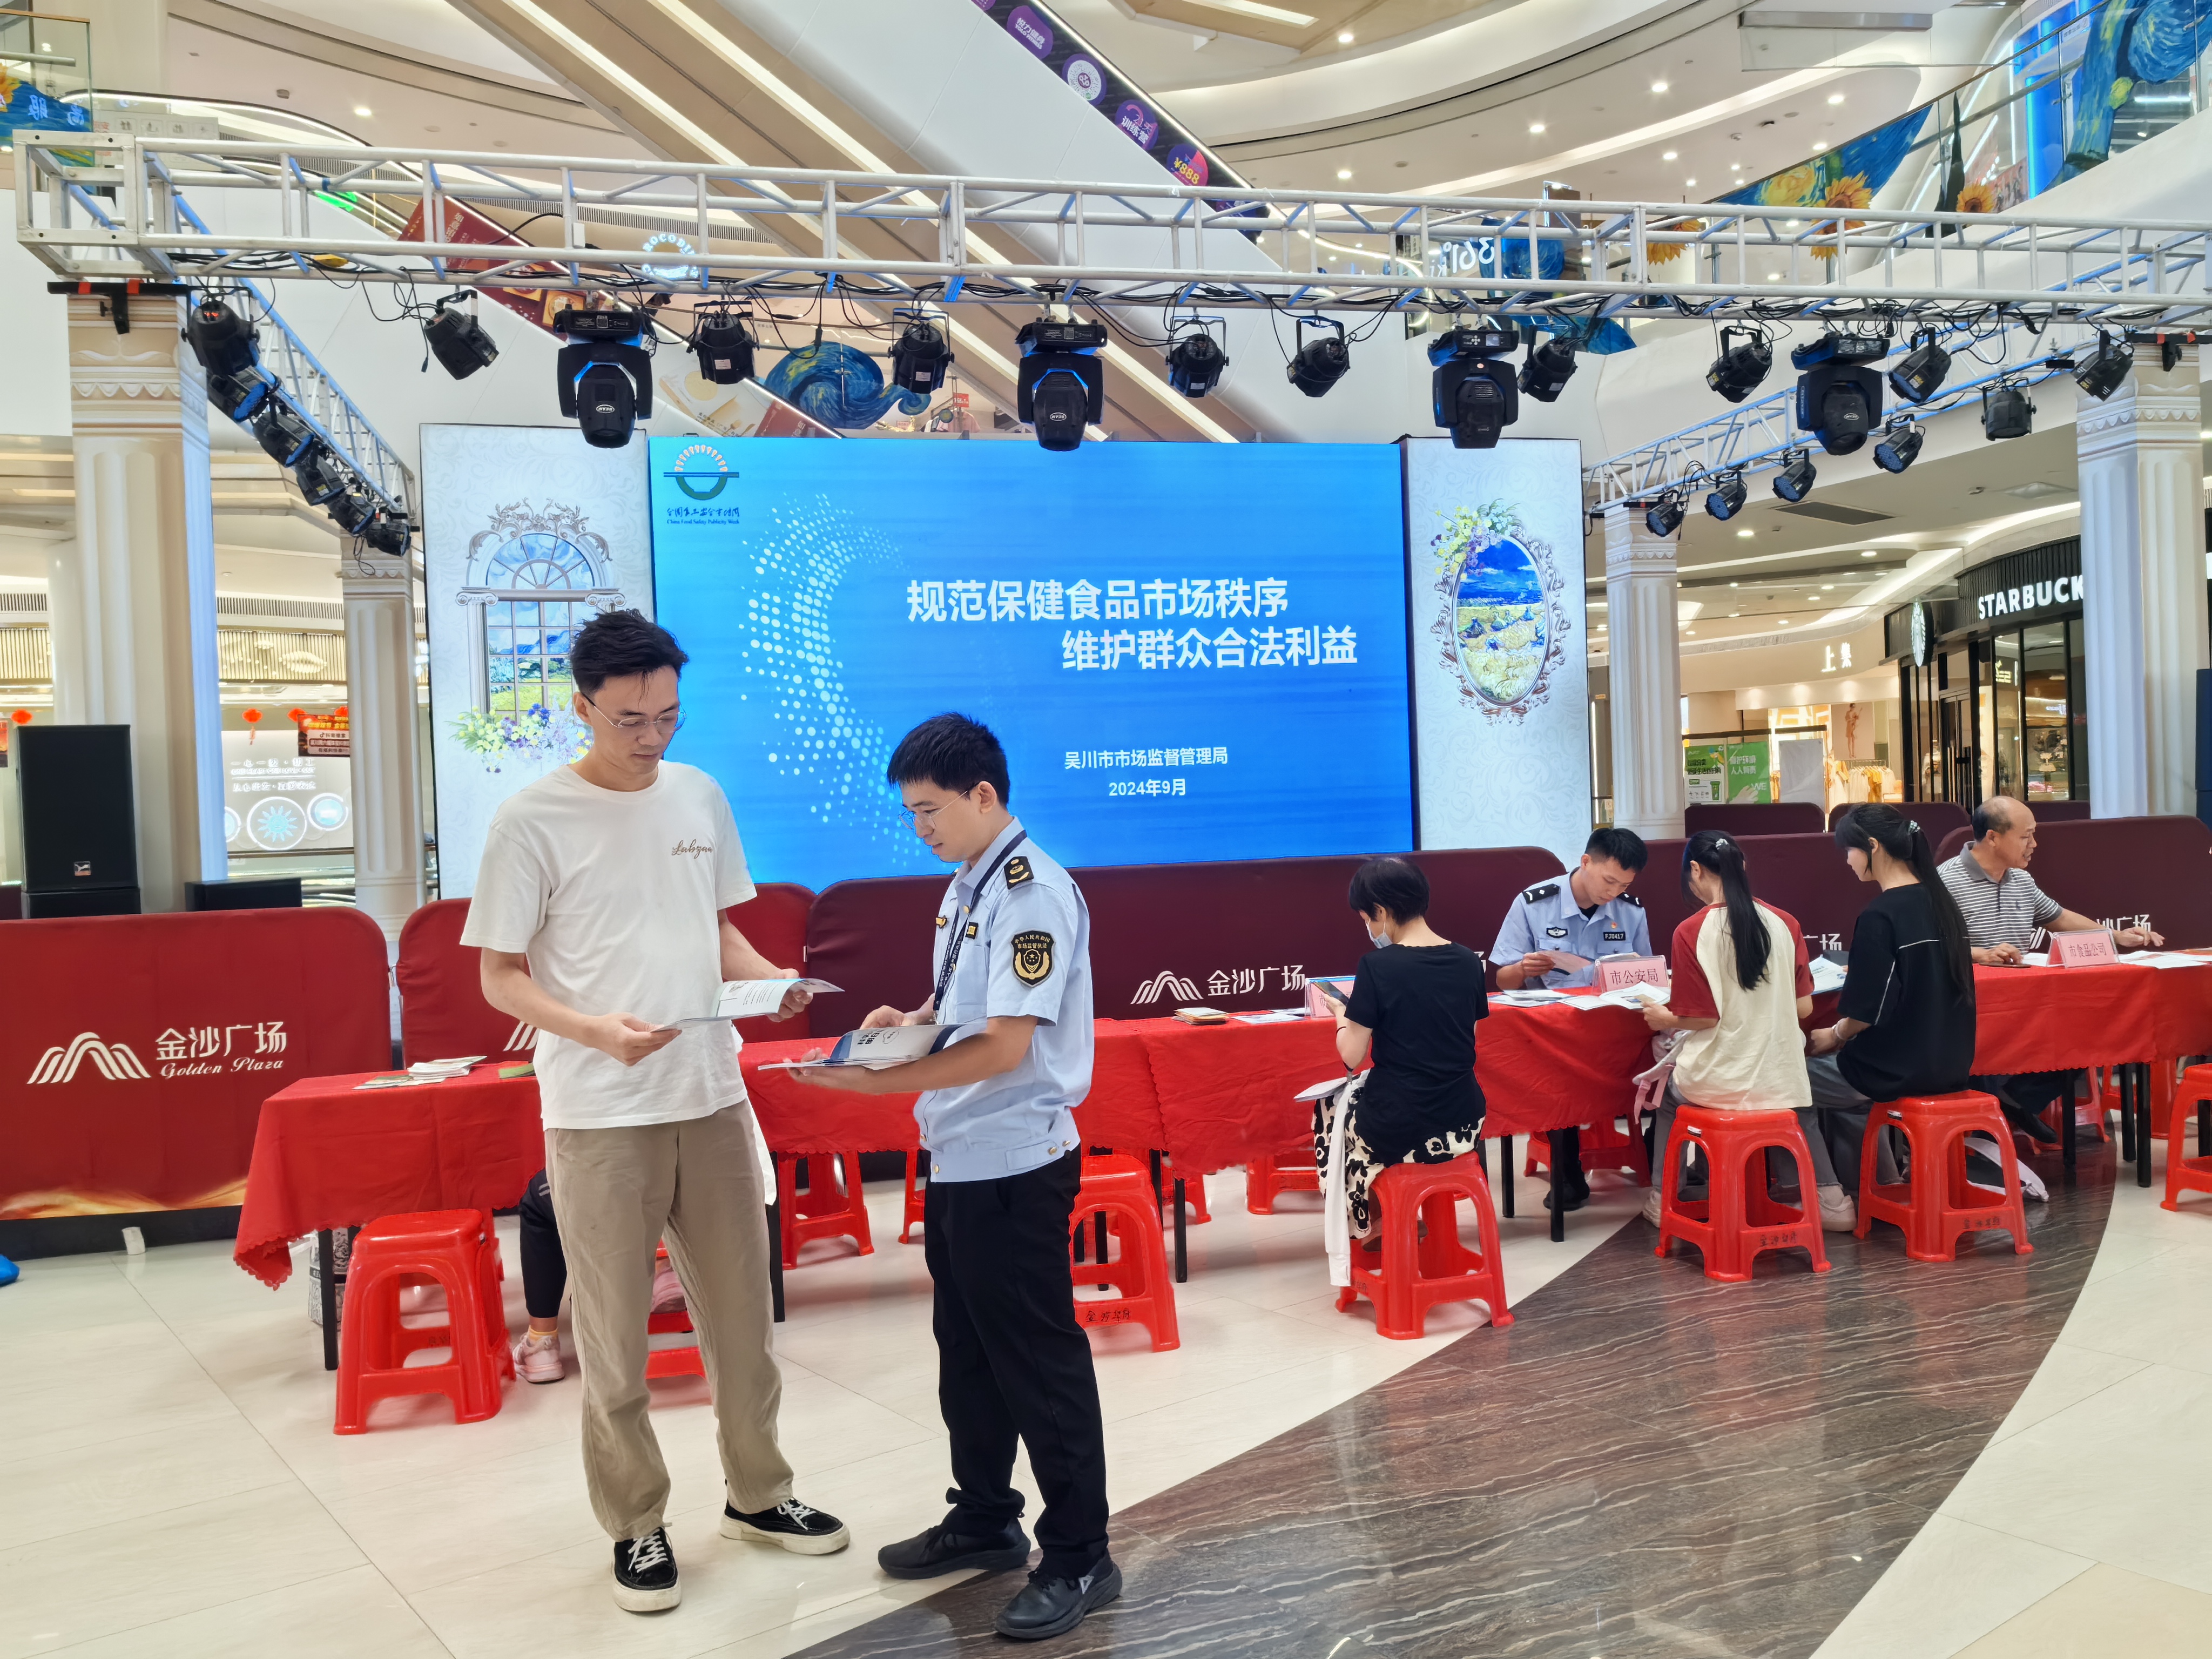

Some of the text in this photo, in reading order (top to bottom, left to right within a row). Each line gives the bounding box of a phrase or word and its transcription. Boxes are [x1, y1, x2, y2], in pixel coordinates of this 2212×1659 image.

[1121, 116, 1149, 144] 训练营
[1174, 157, 1200, 185] ¥888
[906, 577, 1289, 623] 规范保健食品市场秩序
[1978, 575, 2083, 619] STARBUCK
[1061, 625, 1358, 671] 维护群众合法利益
[1064, 746, 1229, 770] 吴川市市场监督管理局
[1108, 778, 1186, 797] 2024年9月
[1014, 934, 1050, 944] 中华人民共和国
[1206, 965, 1305, 996] 金沙广场
[1610, 968, 1658, 986] 市公安局
[155, 1021, 287, 1061] 金沙广场
[159, 1056, 284, 1080] Golden Plaza
